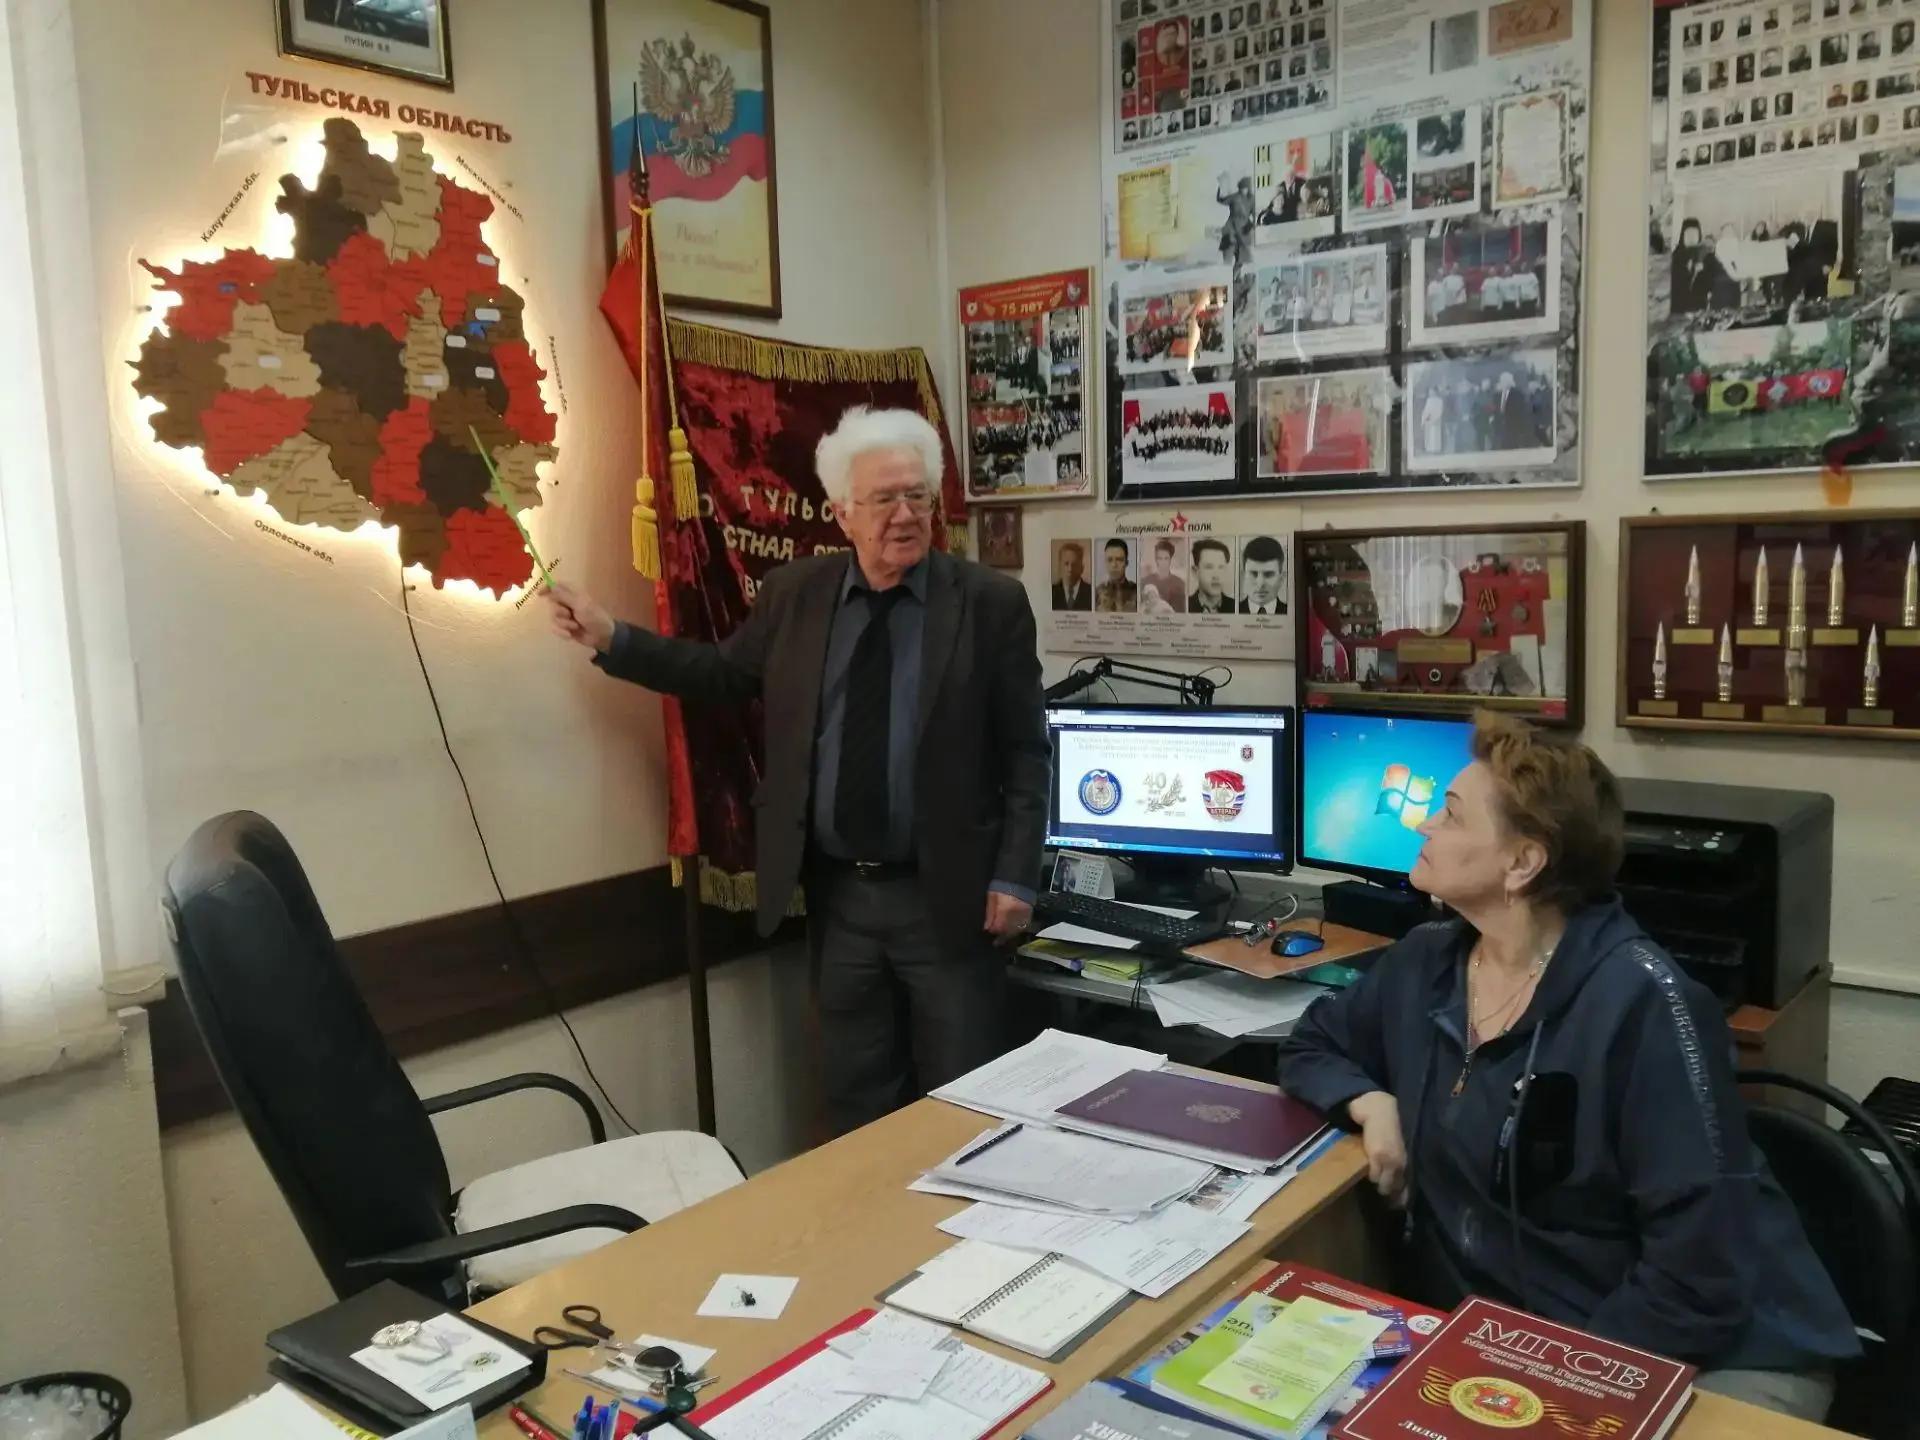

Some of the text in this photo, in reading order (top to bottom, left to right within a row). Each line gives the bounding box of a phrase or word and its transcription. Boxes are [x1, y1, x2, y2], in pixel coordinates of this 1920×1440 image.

[246, 71, 512, 143] ТУЛЬСКАЯ ОБЛАСТЬ
[200, 189, 244, 243] Калужская
[1001, 302, 1017, 316] 75
[254, 519, 312, 553] Орловская
[1469, 1317, 1650, 1390] МГСВ
